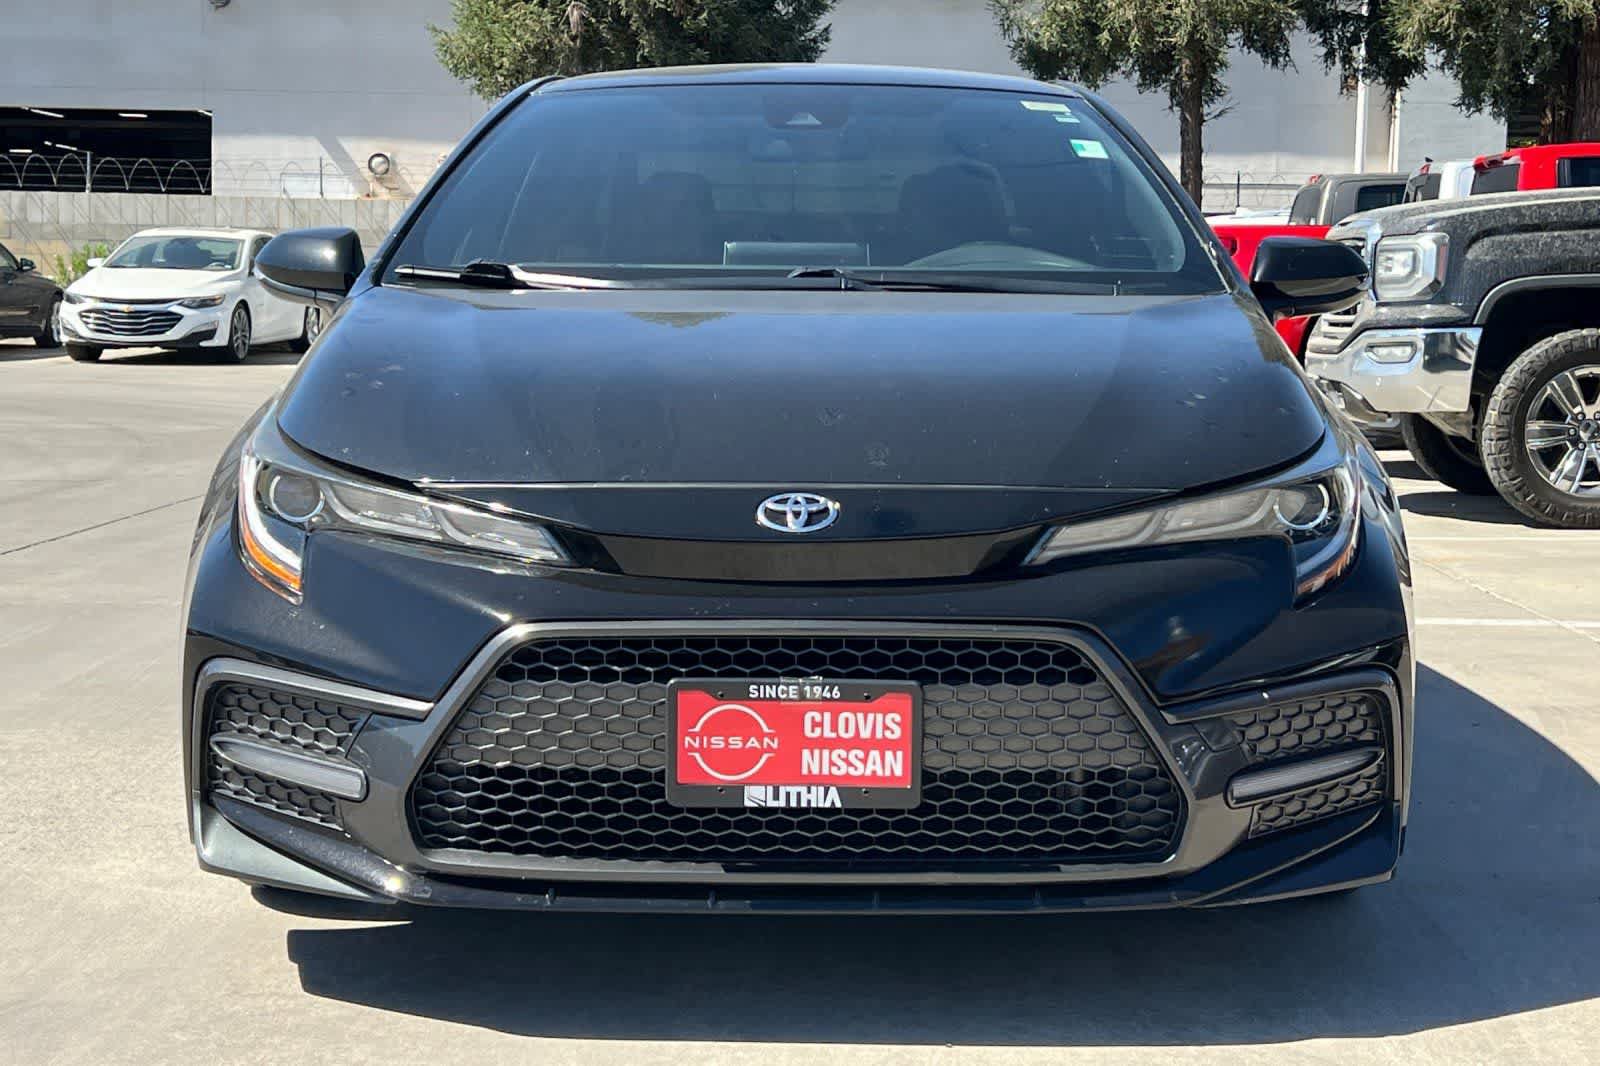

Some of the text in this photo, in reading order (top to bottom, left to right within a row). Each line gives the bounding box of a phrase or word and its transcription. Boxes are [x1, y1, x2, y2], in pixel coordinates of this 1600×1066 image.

[749, 685, 841, 700] SINCE 1946
[803, 711, 902, 740] CLOVIS
[684, 736, 779, 749] NISSAN
[801, 749, 904, 777] NISSAN
[766, 785, 842, 808] LITHIA
